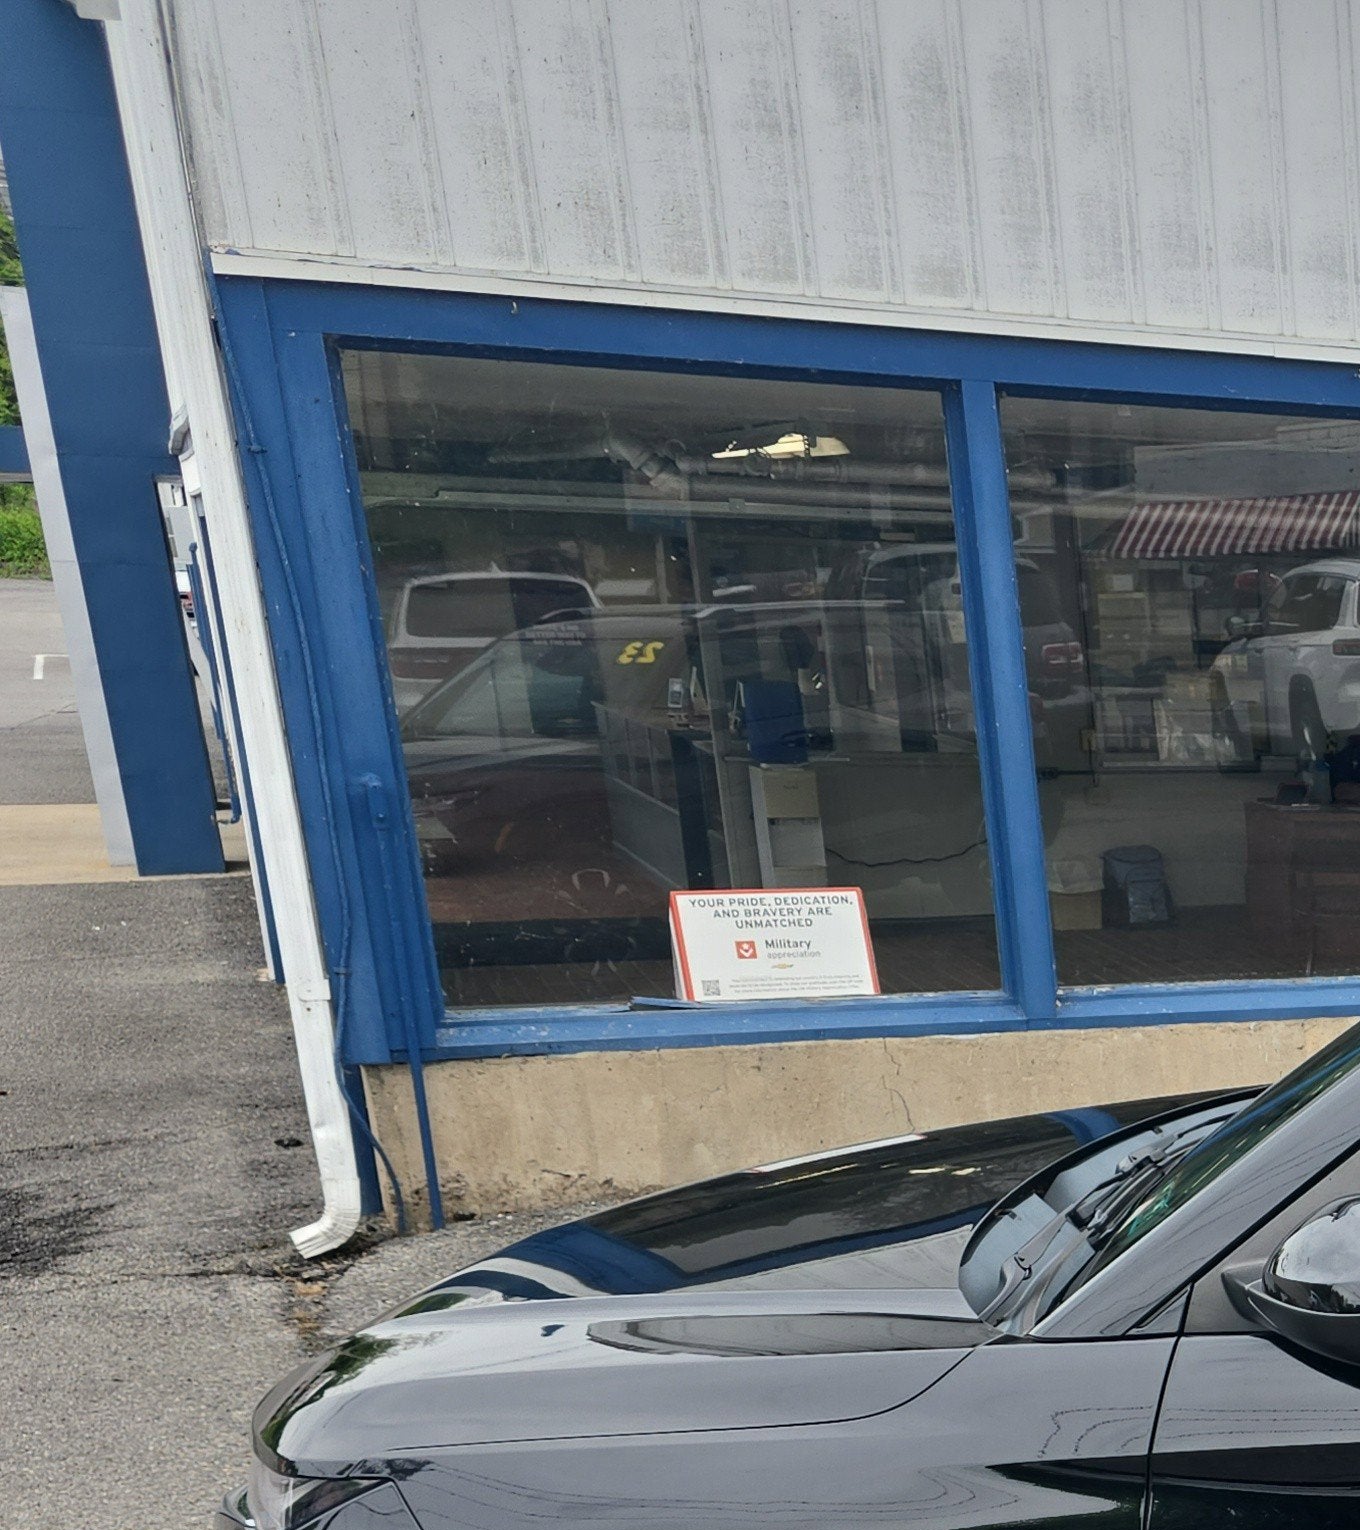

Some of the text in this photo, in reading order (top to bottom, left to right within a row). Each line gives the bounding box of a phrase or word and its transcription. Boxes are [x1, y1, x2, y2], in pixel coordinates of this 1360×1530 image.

[689, 896, 854, 907] YOUR PRIDE, DEDICATION,
[713, 906, 833, 917] AND BRAVERY ARE
[735, 918, 814, 929] UNMATCHED
[764, 938, 812, 950] Military
[766, 950, 822, 960] appreciation
